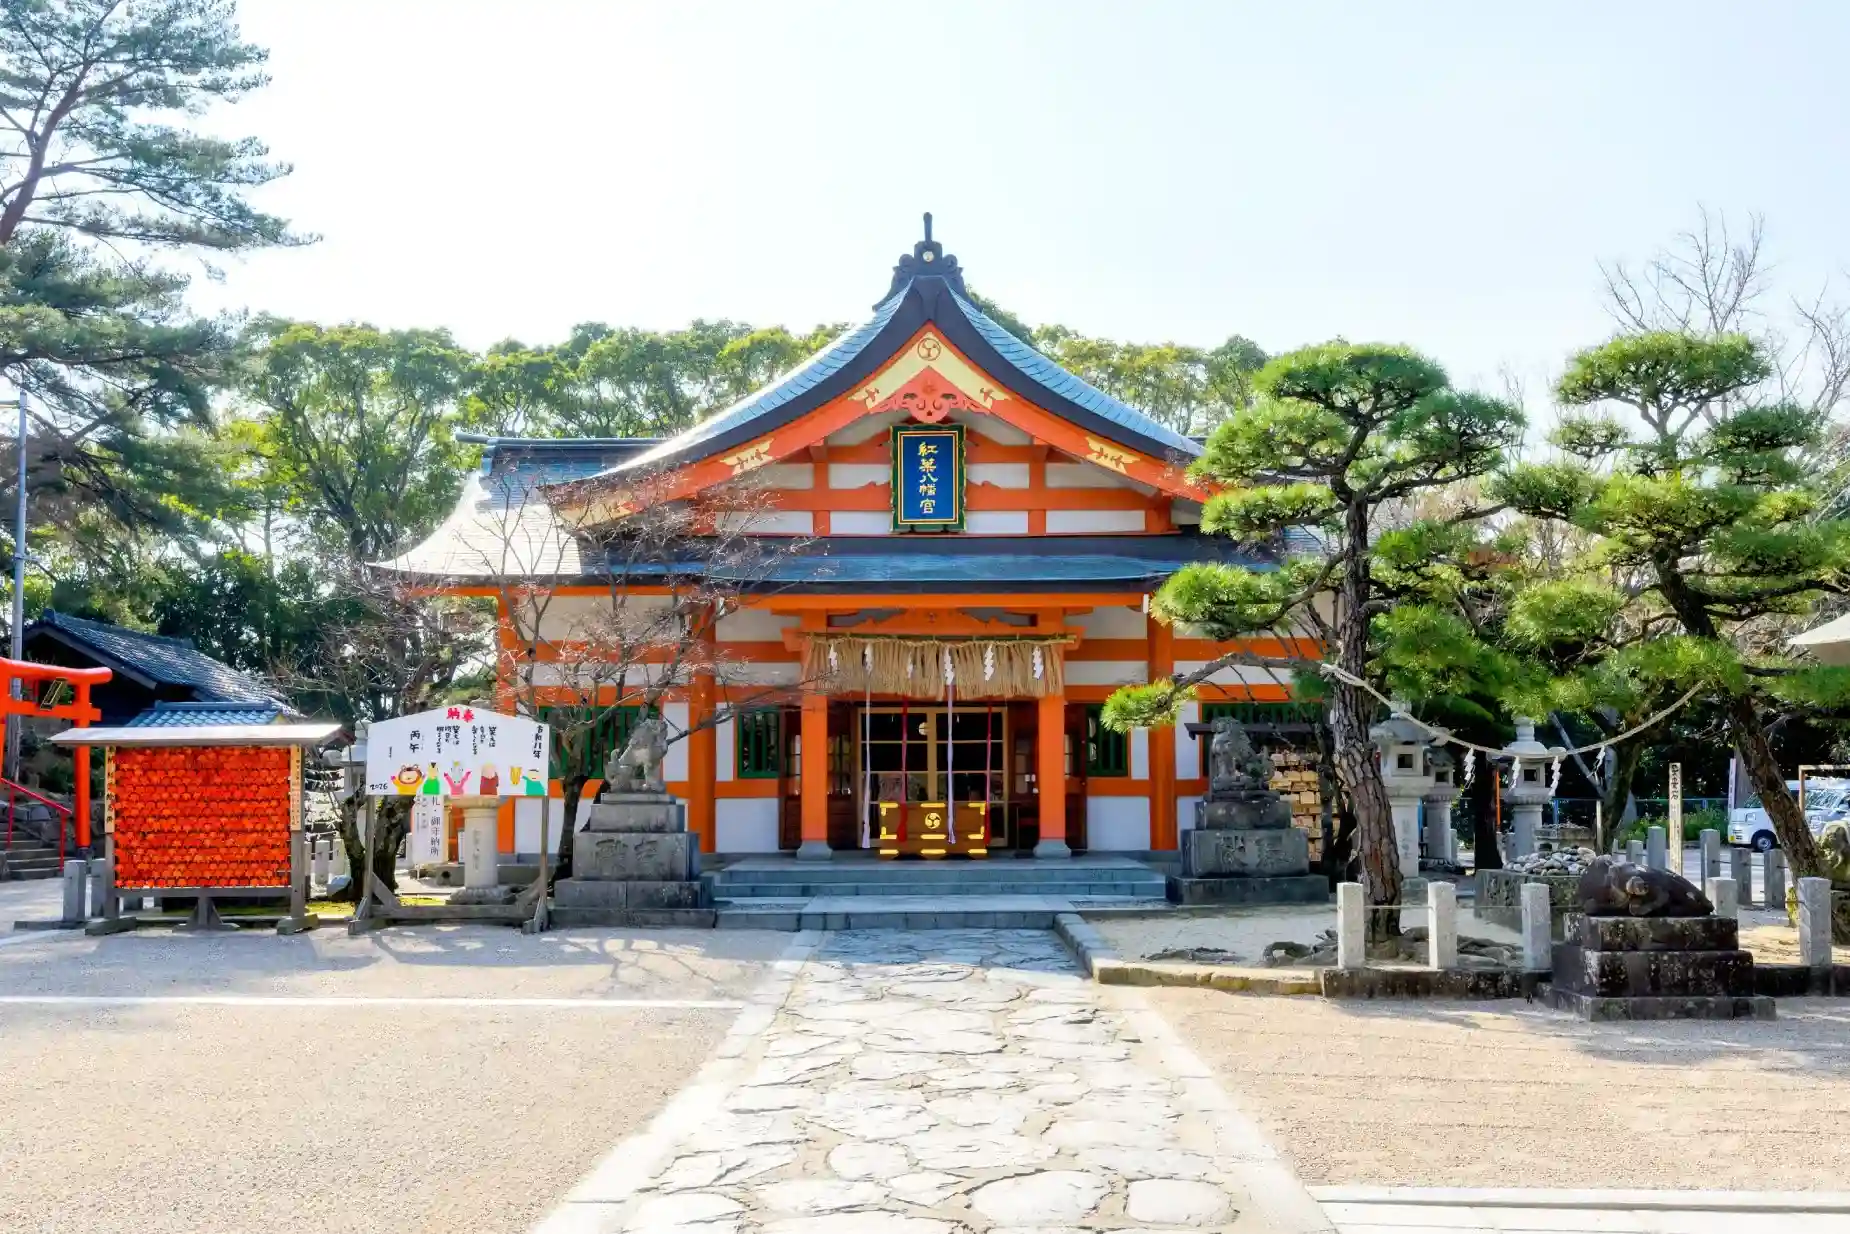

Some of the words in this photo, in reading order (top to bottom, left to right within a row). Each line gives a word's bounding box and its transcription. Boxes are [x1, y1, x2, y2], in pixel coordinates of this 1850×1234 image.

[918, 440, 938, 514] 紅葉八幡宮
[409, 730, 420, 753] 丙午
